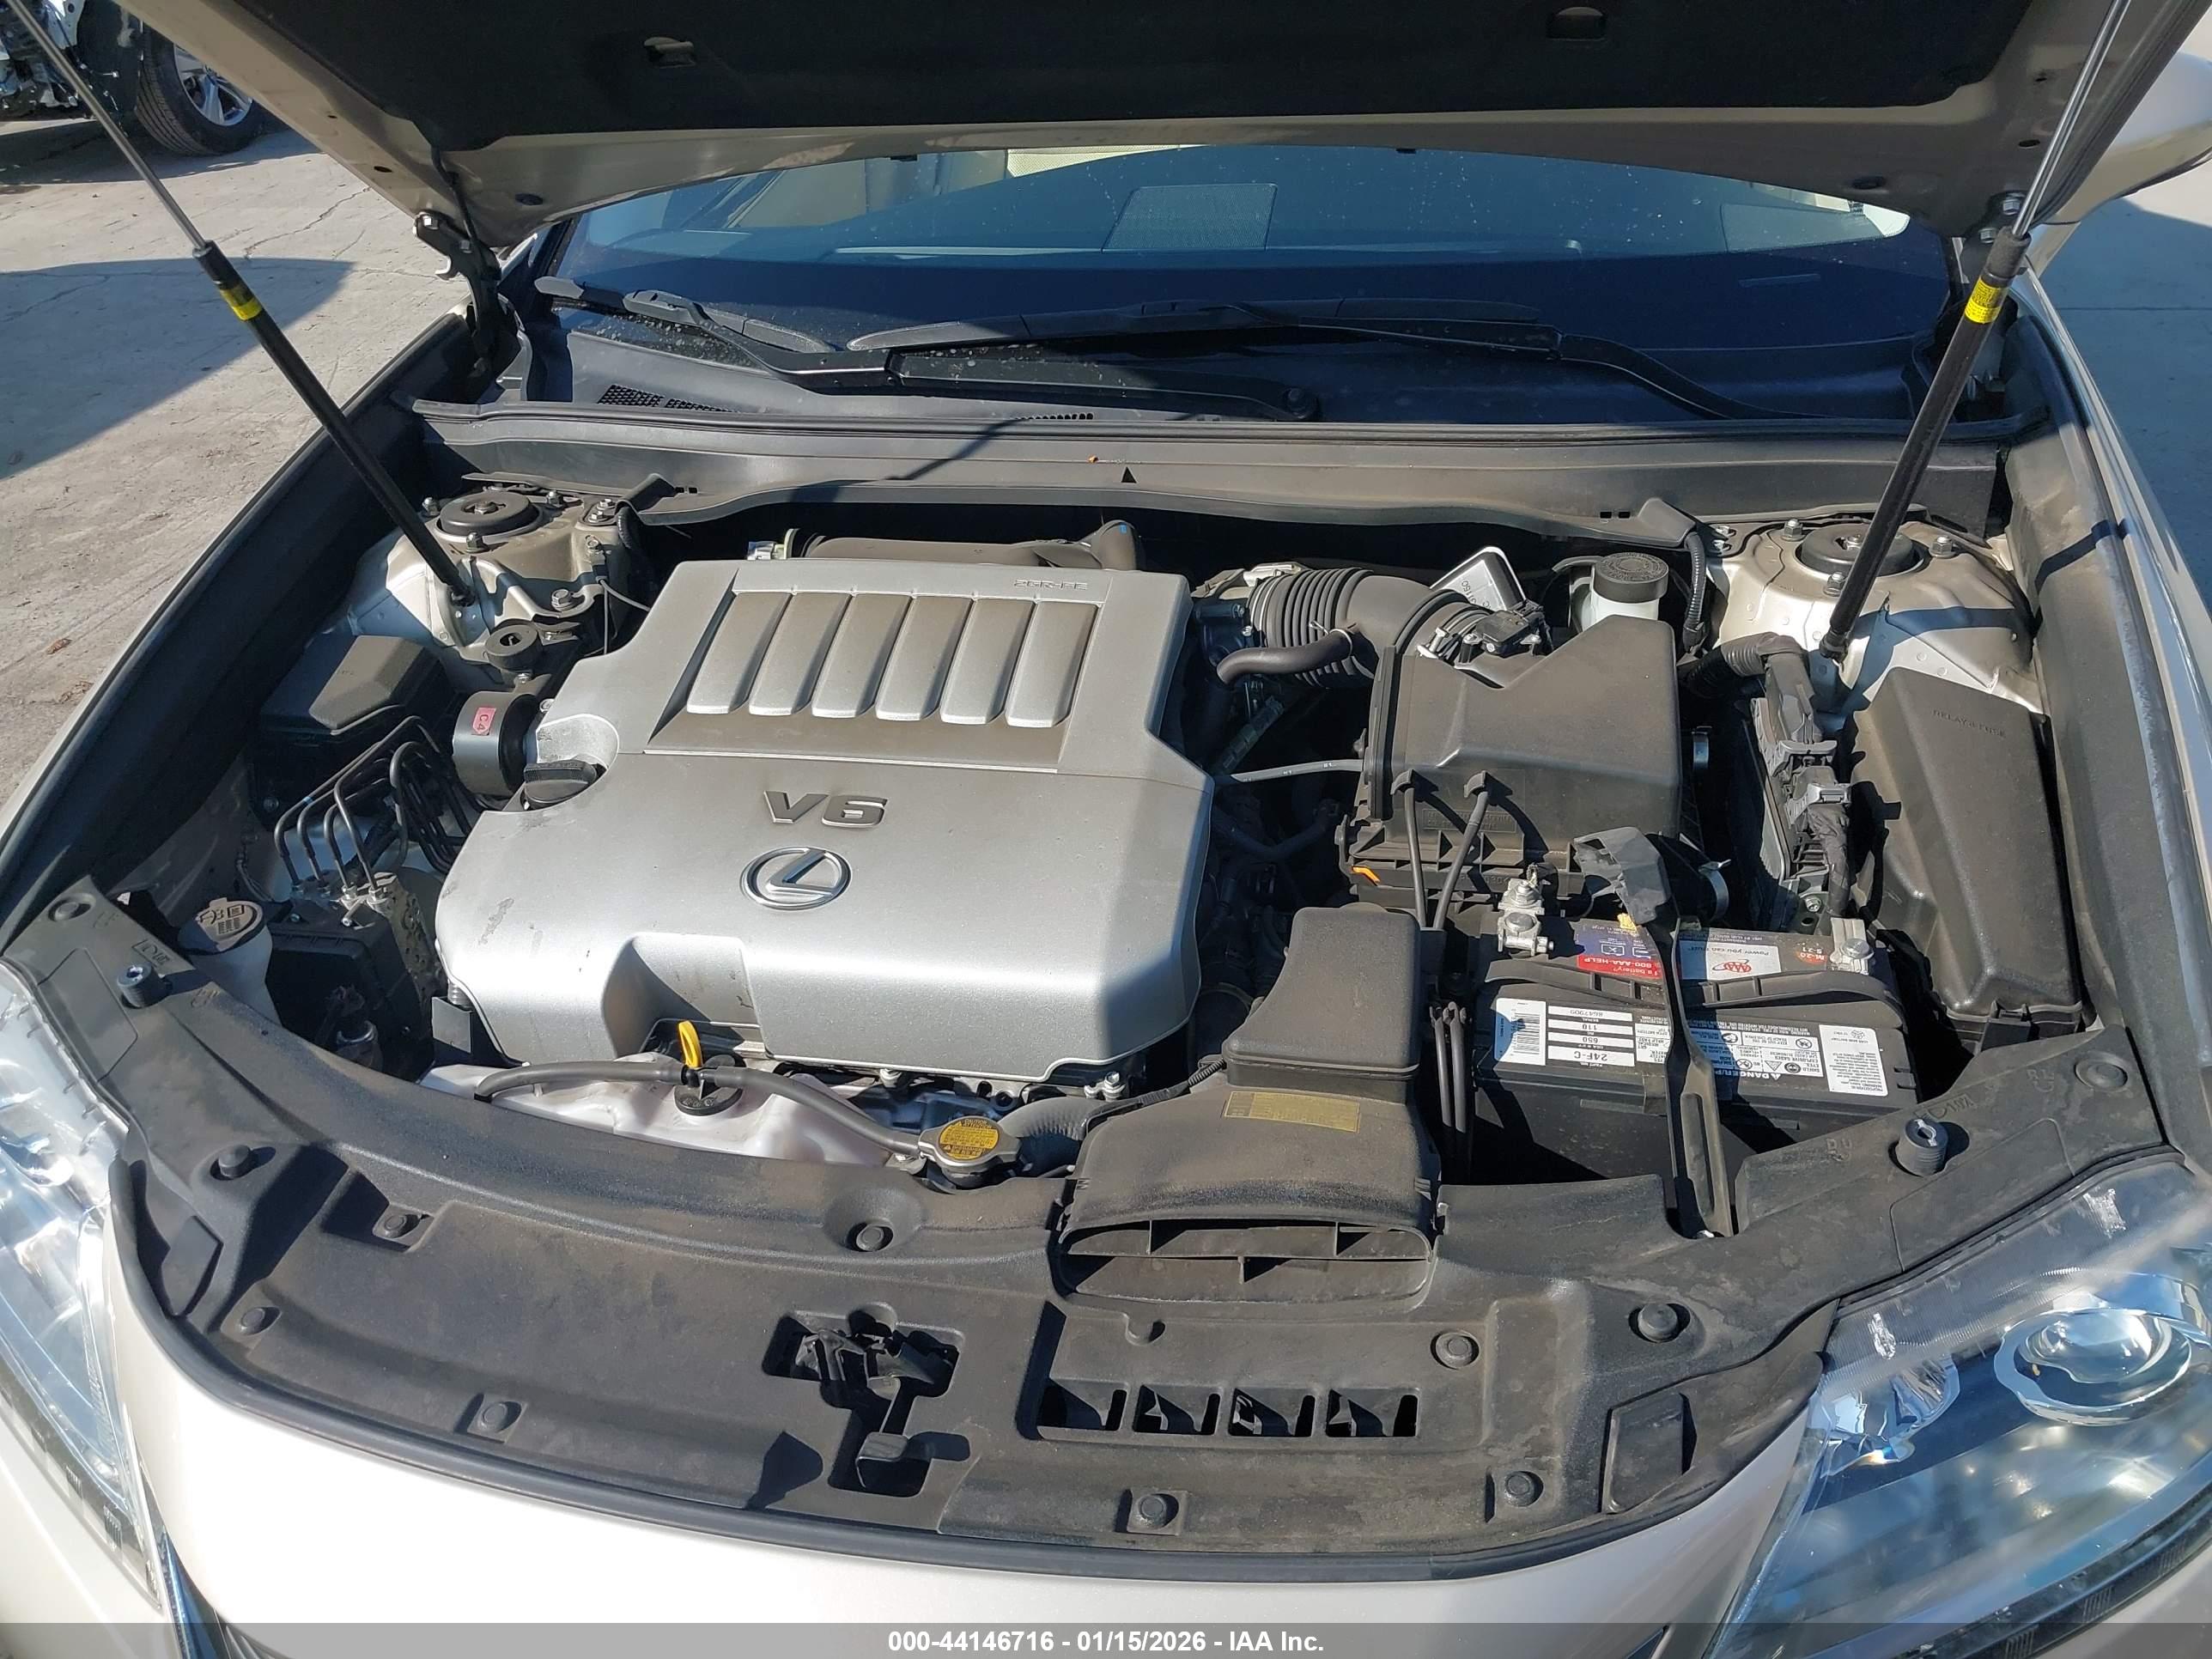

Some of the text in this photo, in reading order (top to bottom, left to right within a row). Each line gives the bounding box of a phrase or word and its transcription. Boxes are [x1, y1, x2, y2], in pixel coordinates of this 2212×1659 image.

[1014, 579, 1088, 591] 2GR-FE
[763, 789, 888, 829] V6
[1574, 1050, 1608, 1062] 24F-C
